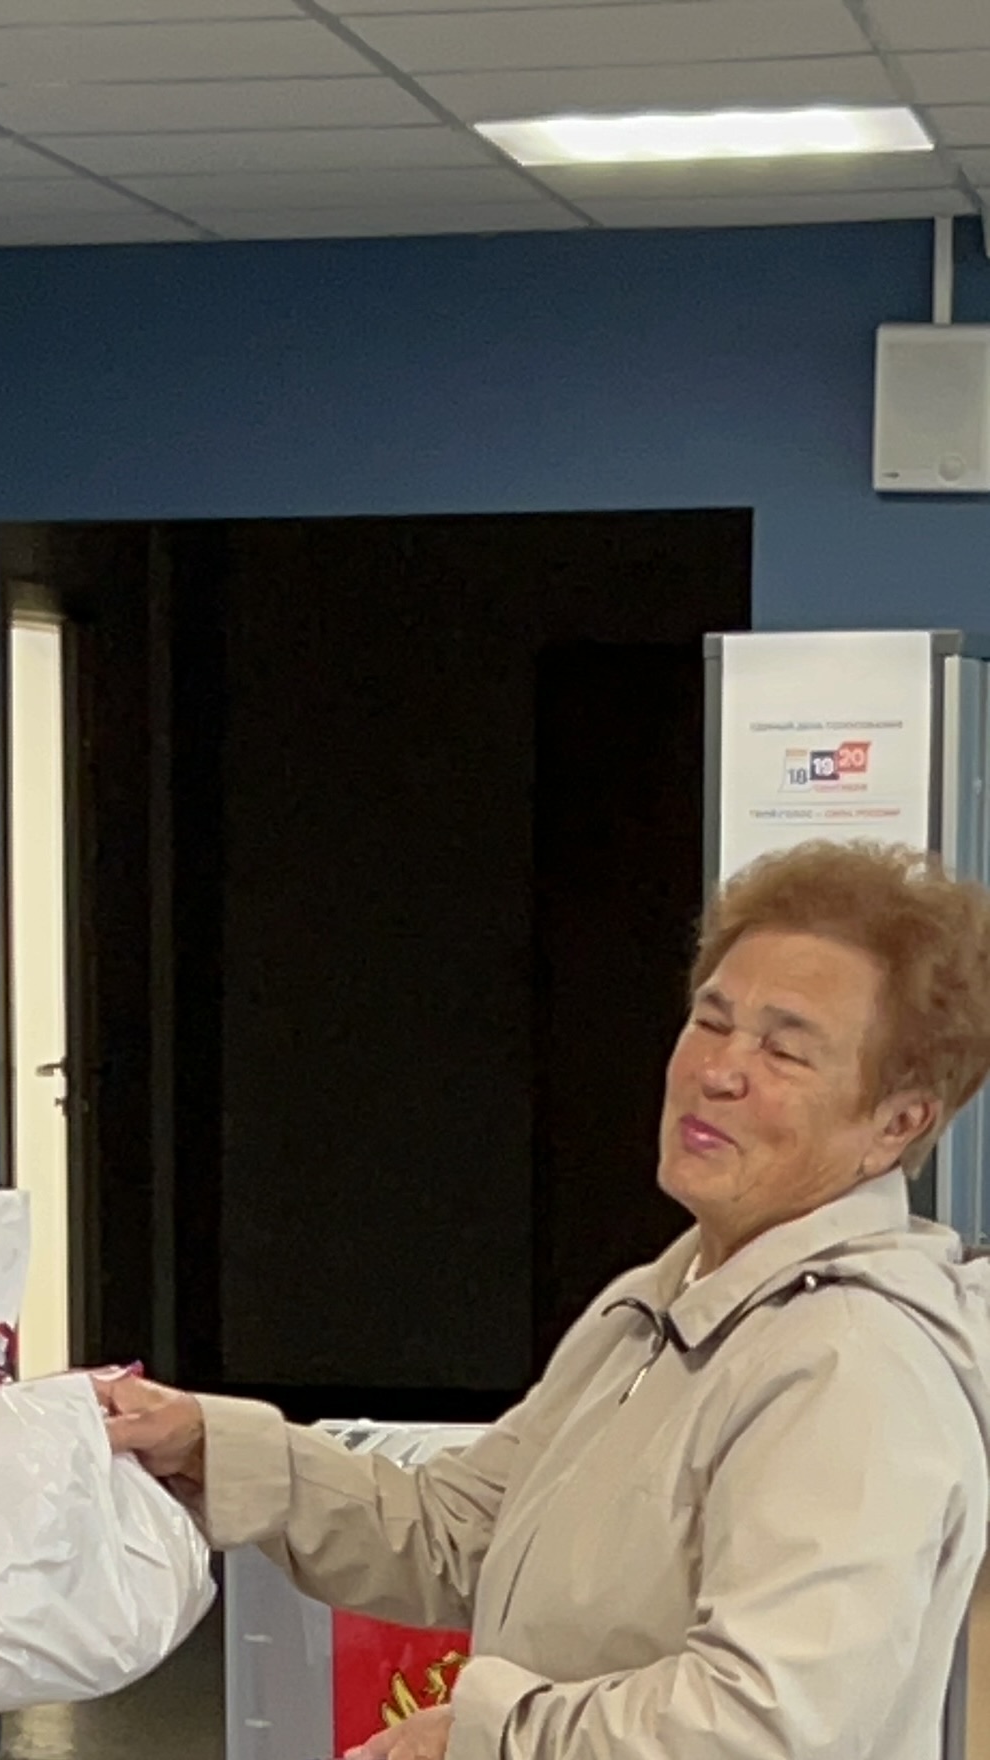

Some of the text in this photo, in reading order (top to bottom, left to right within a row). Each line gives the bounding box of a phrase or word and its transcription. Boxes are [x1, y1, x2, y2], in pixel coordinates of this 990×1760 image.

[788, 748, 865, 785] 18 19 20
